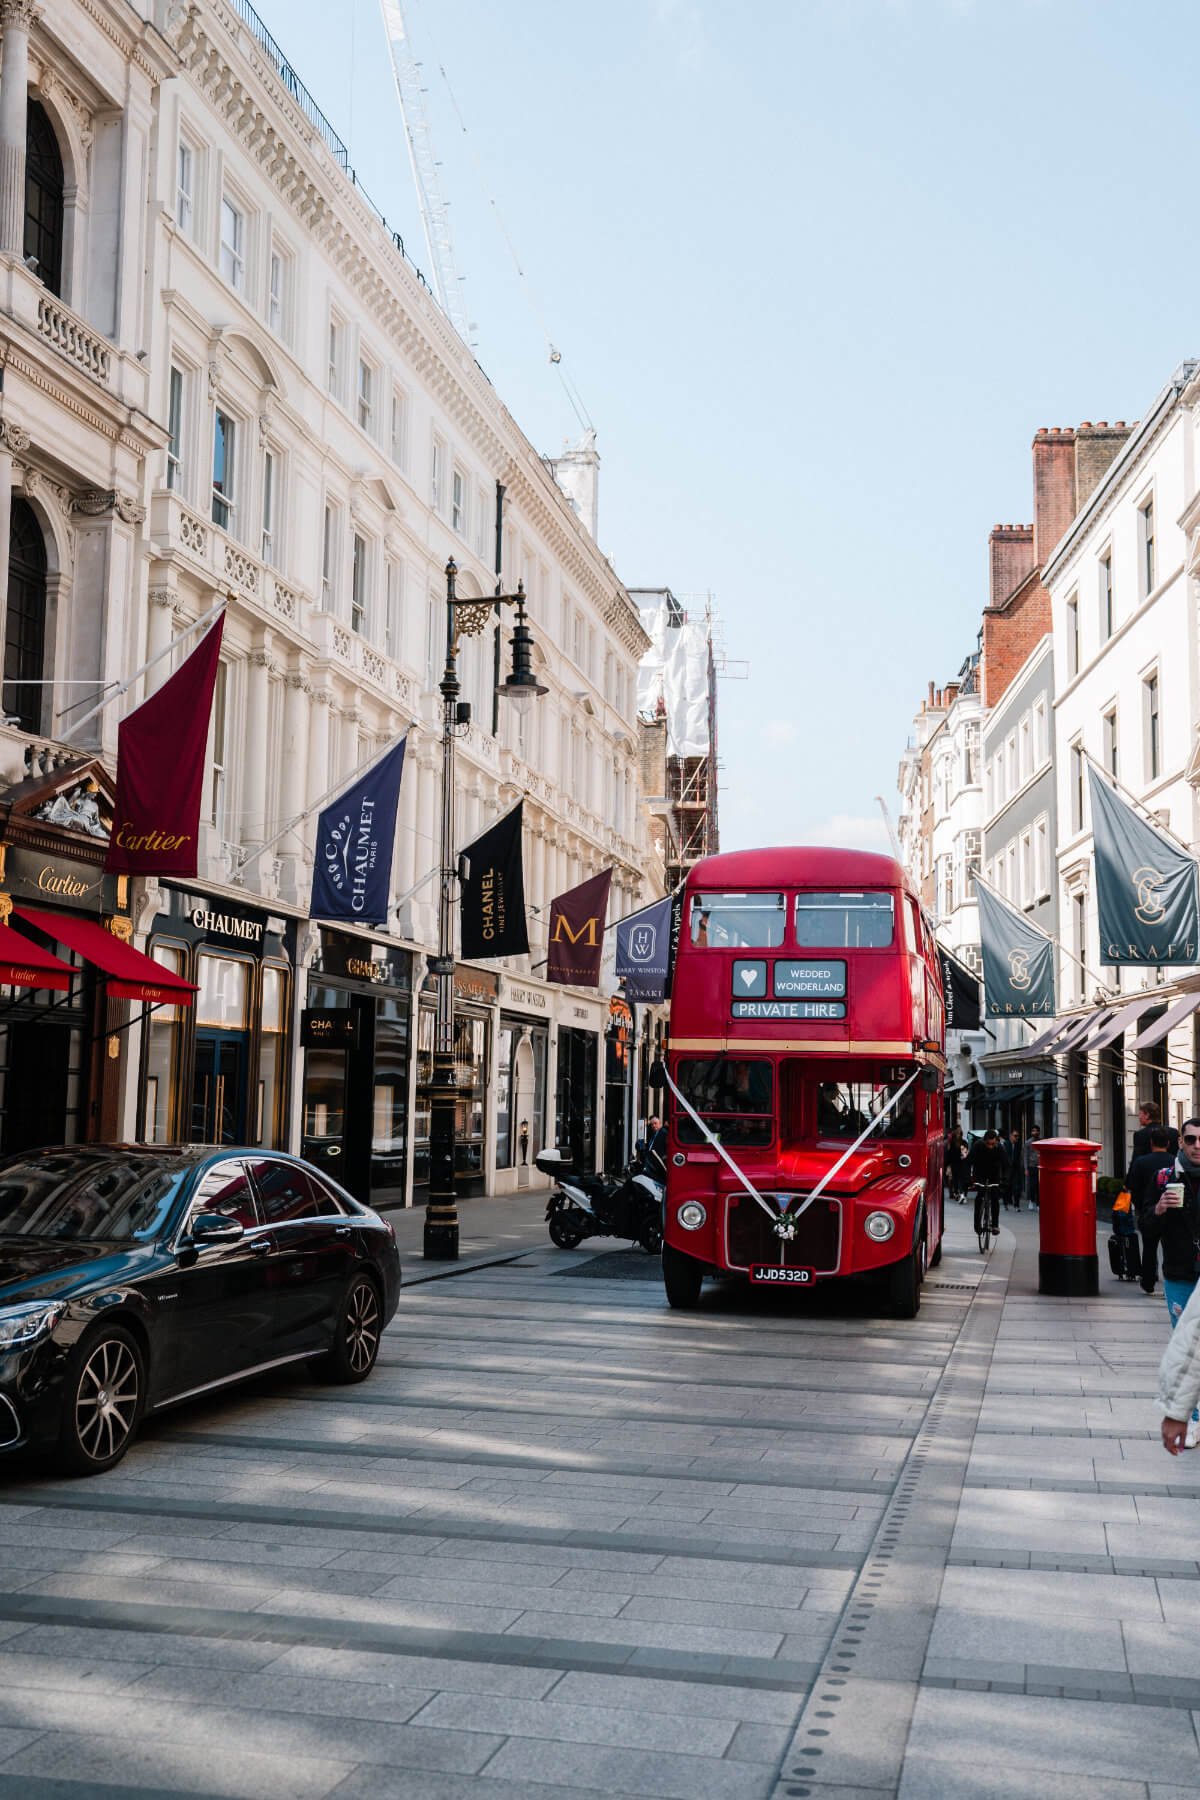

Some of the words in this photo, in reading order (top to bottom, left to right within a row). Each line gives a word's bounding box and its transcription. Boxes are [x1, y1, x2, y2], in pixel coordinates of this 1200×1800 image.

[116, 822, 191, 850] Cartier
[351, 796, 375, 911] CHAUMET
[369, 841, 378, 868] PARIS
[38, 866, 89, 896] Cartier
[482, 868, 495, 940] CHANEL
[193, 908, 263, 942] CHAUMET
[671, 903, 682, 933] Arpels
[550, 914, 600, 946] M
[638, 931, 648, 943] H
[634, 943, 649, 955] W
[1108, 943, 1195, 959] GRAFF
[790, 969, 831, 979] WEDDED
[776, 982, 844, 992] WONDERLAND
[739, 1003, 799, 1017] PRIVATE
[804, 1003, 838, 1017] HIRE
[991, 1002, 1051, 1013] GRAFF
[310, 1020, 353, 1030] CHAL
[945, 1011, 953, 1025] Van
[891, 1067, 906, 1081] 15
[755, 1268, 809, 1282] JJD532D
